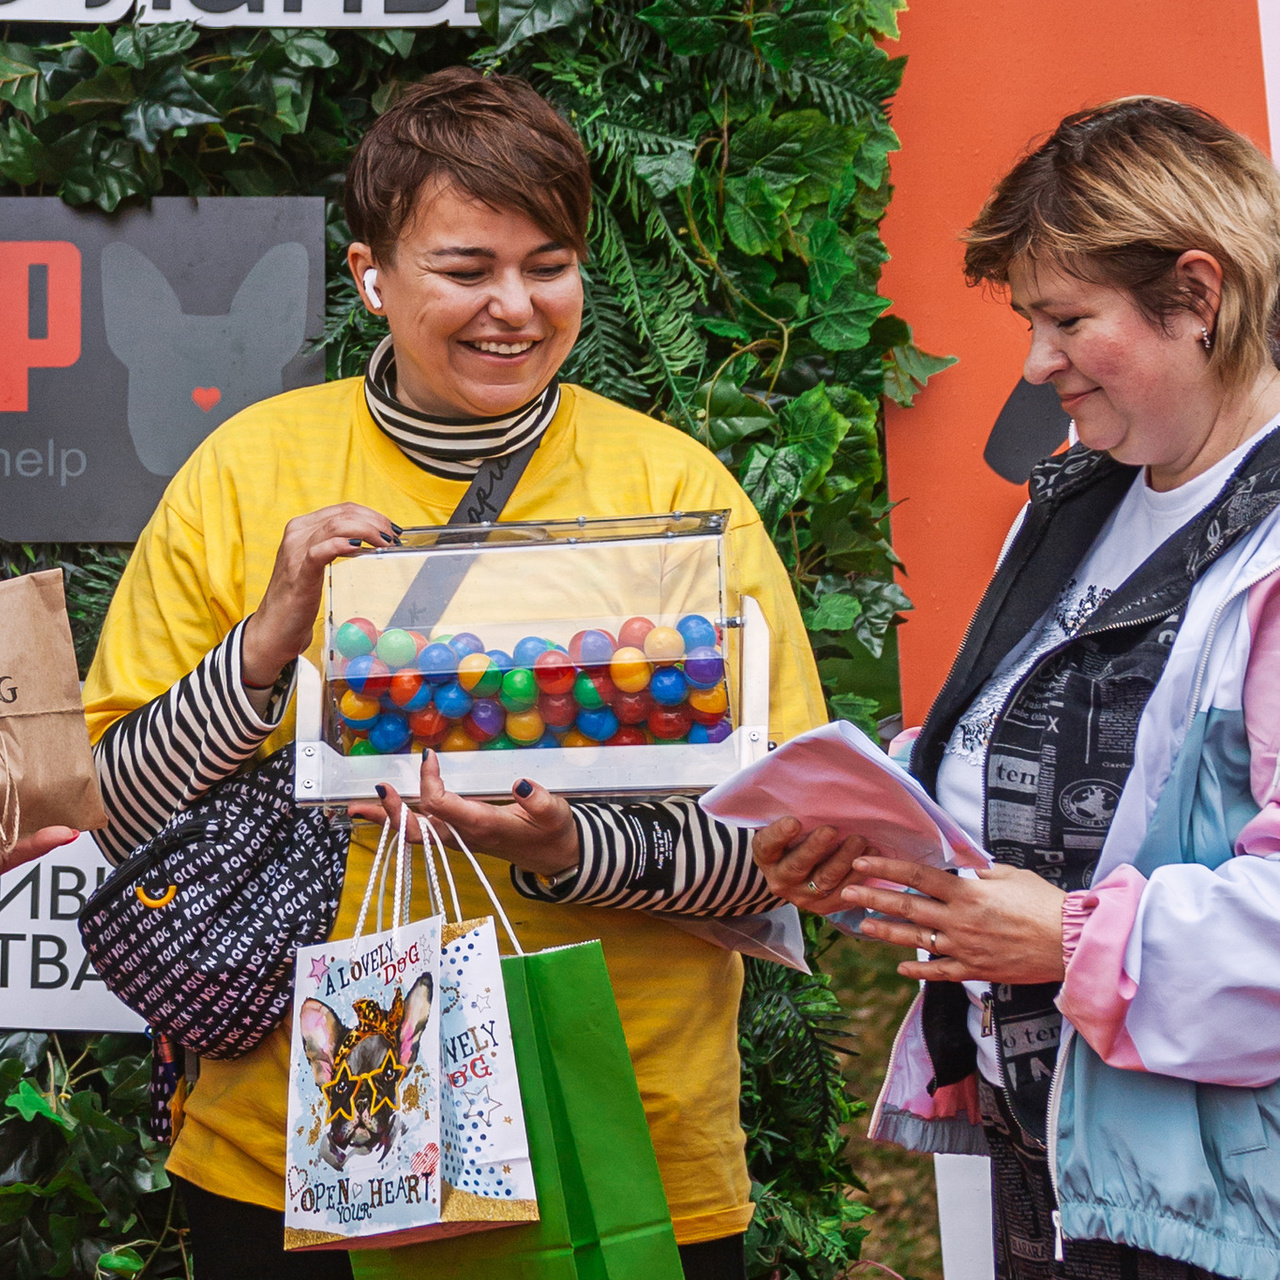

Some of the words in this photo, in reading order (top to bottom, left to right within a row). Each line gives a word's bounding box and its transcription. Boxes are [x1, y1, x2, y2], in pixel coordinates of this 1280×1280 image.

[337, 937, 394, 990] LOVELY
[383, 941, 420, 986] DOG
[301, 1177, 350, 1214] OPEN
[368, 1172, 432, 1209] HEART
[336, 1202, 372, 1224] YOUR
